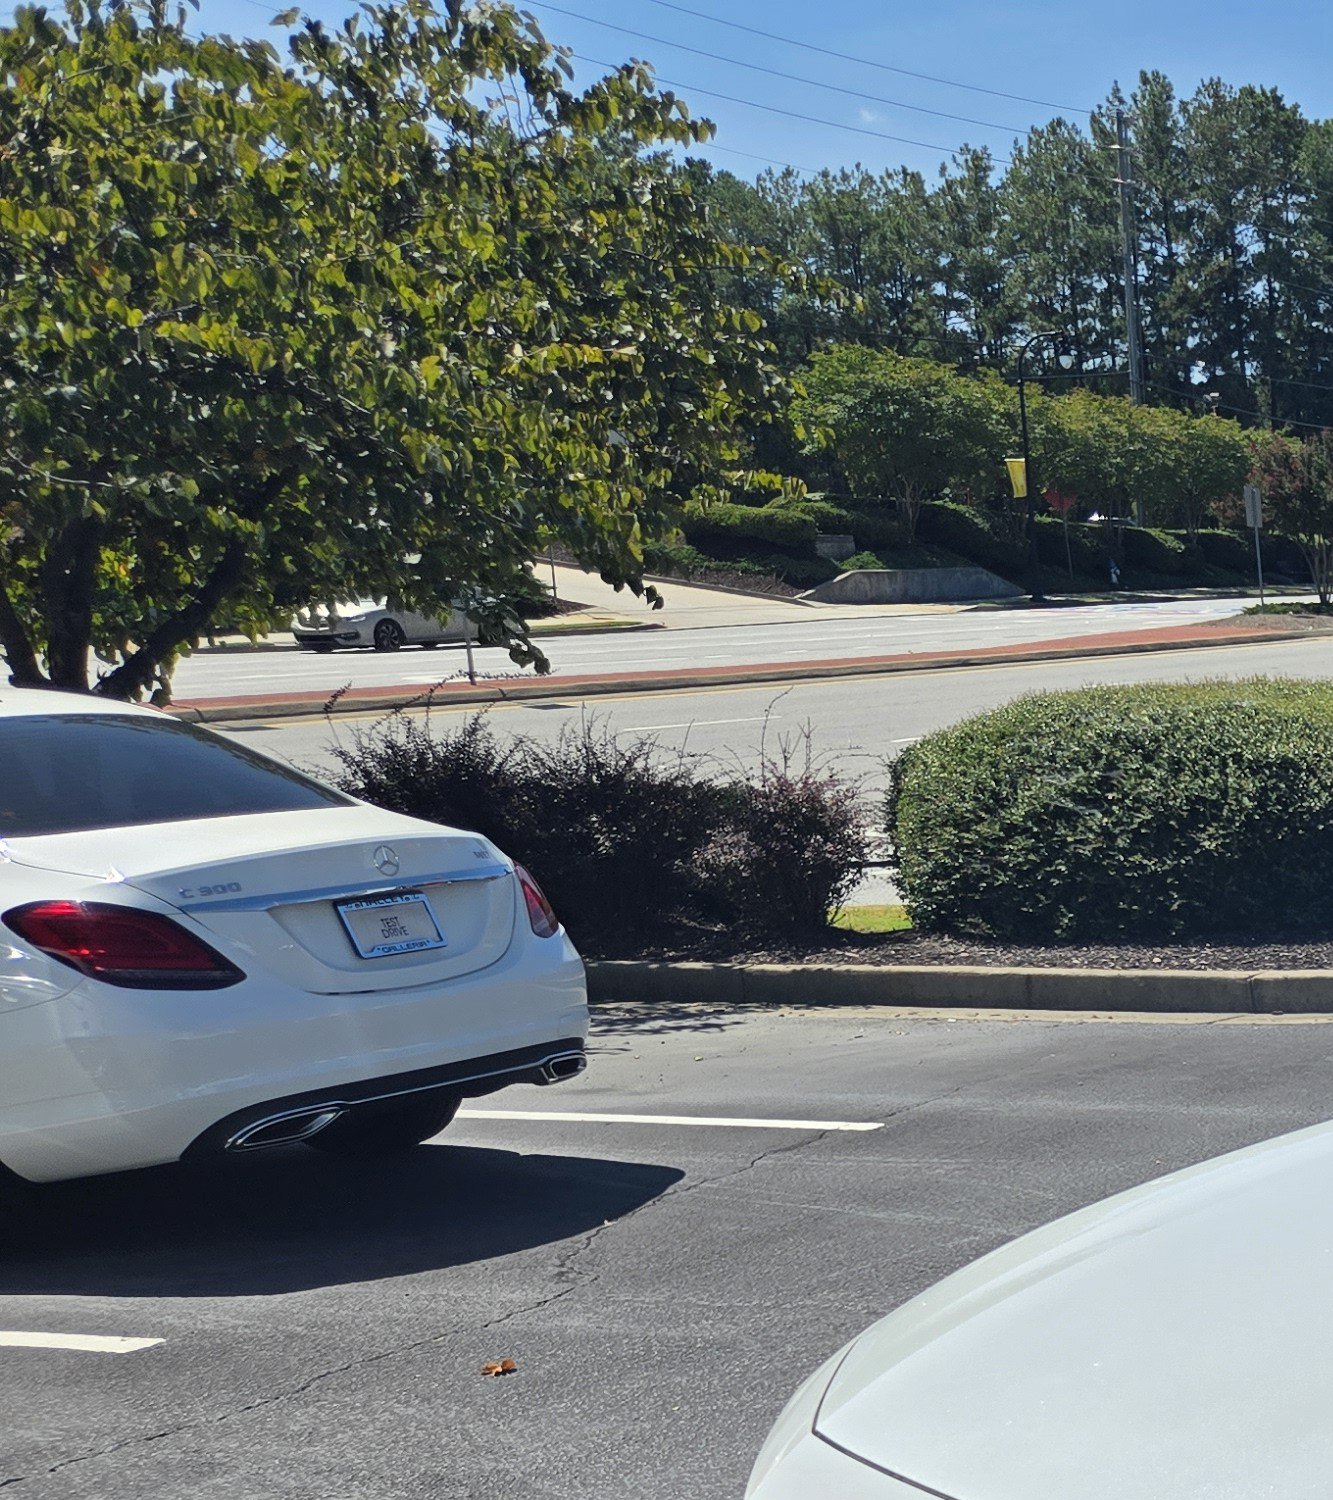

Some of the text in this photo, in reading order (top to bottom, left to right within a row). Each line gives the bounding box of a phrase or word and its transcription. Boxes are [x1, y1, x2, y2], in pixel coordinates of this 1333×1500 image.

[179, 882, 242, 899] C 300
[381, 916, 400, 928] TEST
[381, 926, 410, 939] DRIVE
